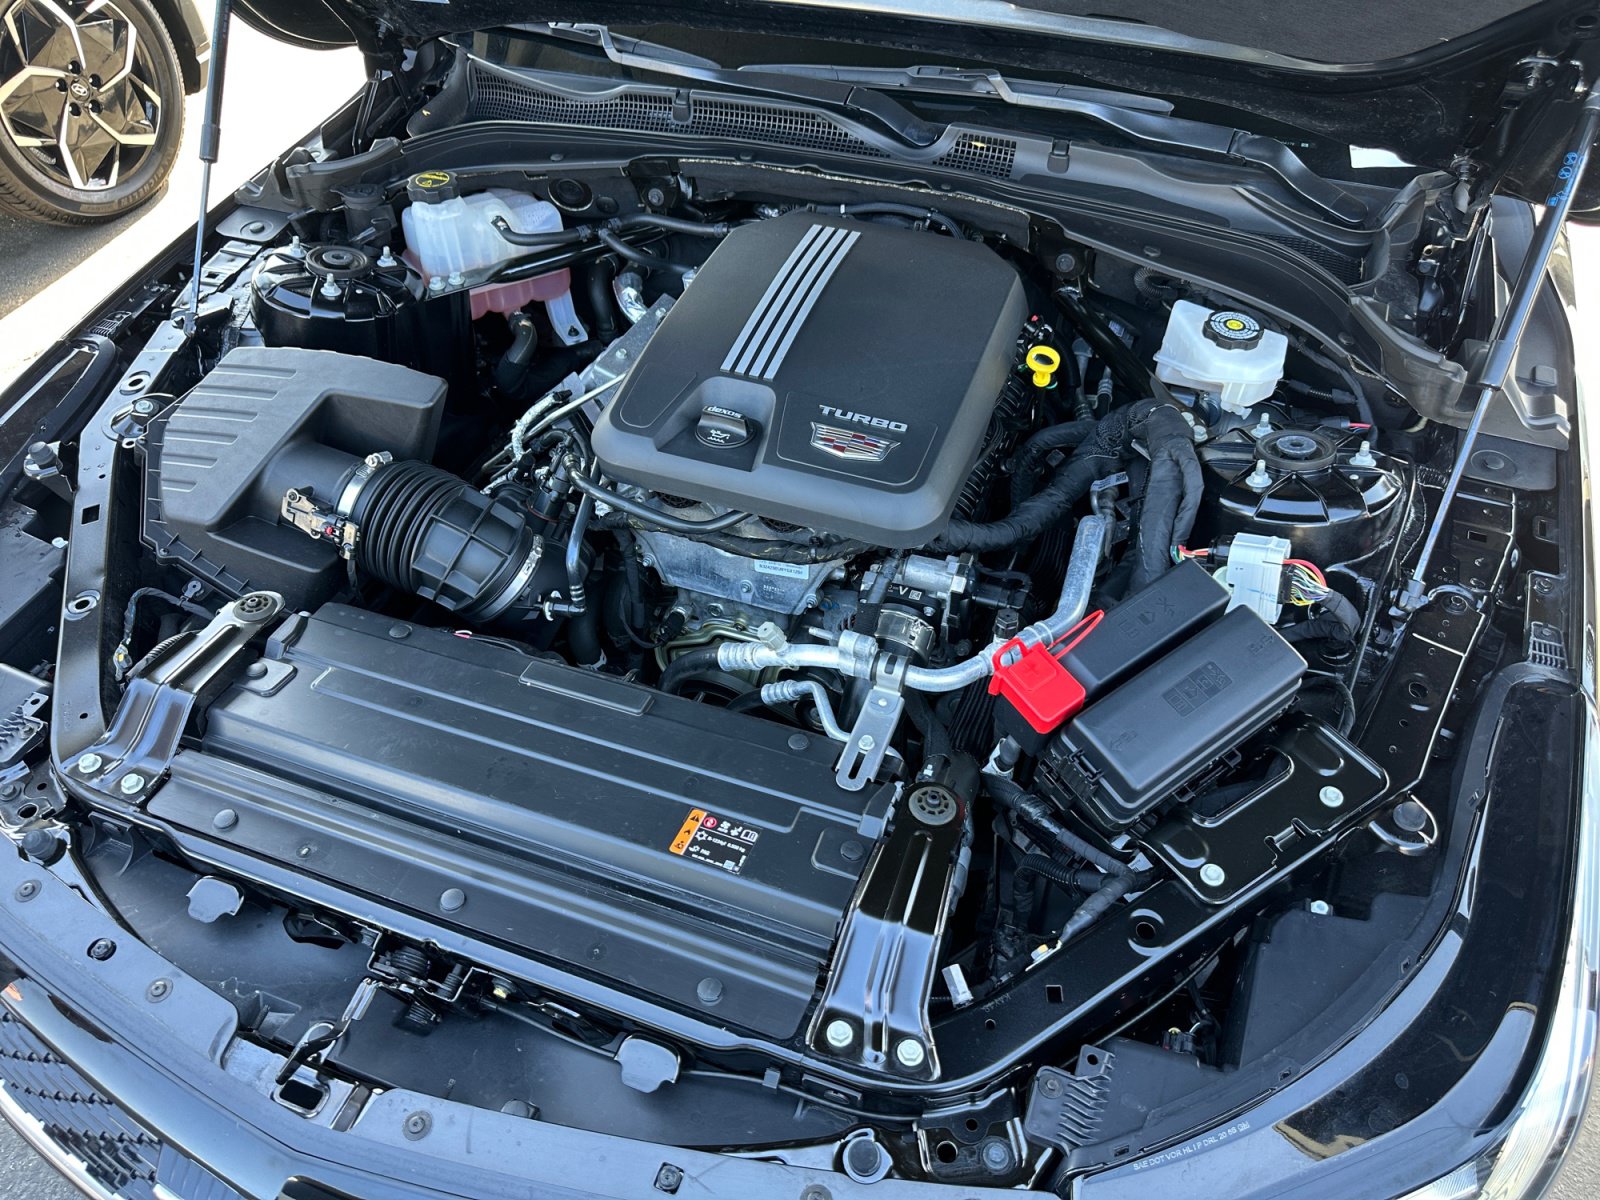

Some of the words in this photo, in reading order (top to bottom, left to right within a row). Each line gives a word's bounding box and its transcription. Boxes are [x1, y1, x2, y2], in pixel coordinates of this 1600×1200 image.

[121, 165, 165, 207] MICHELIN
[707, 405, 742, 419] dexos
[819, 404, 908, 432] TURBO
[1133, 1160, 1149, 1170] SAE
[1149, 1155, 1165, 1166] DOT
[1202, 1136, 1218, 1147] DRL
